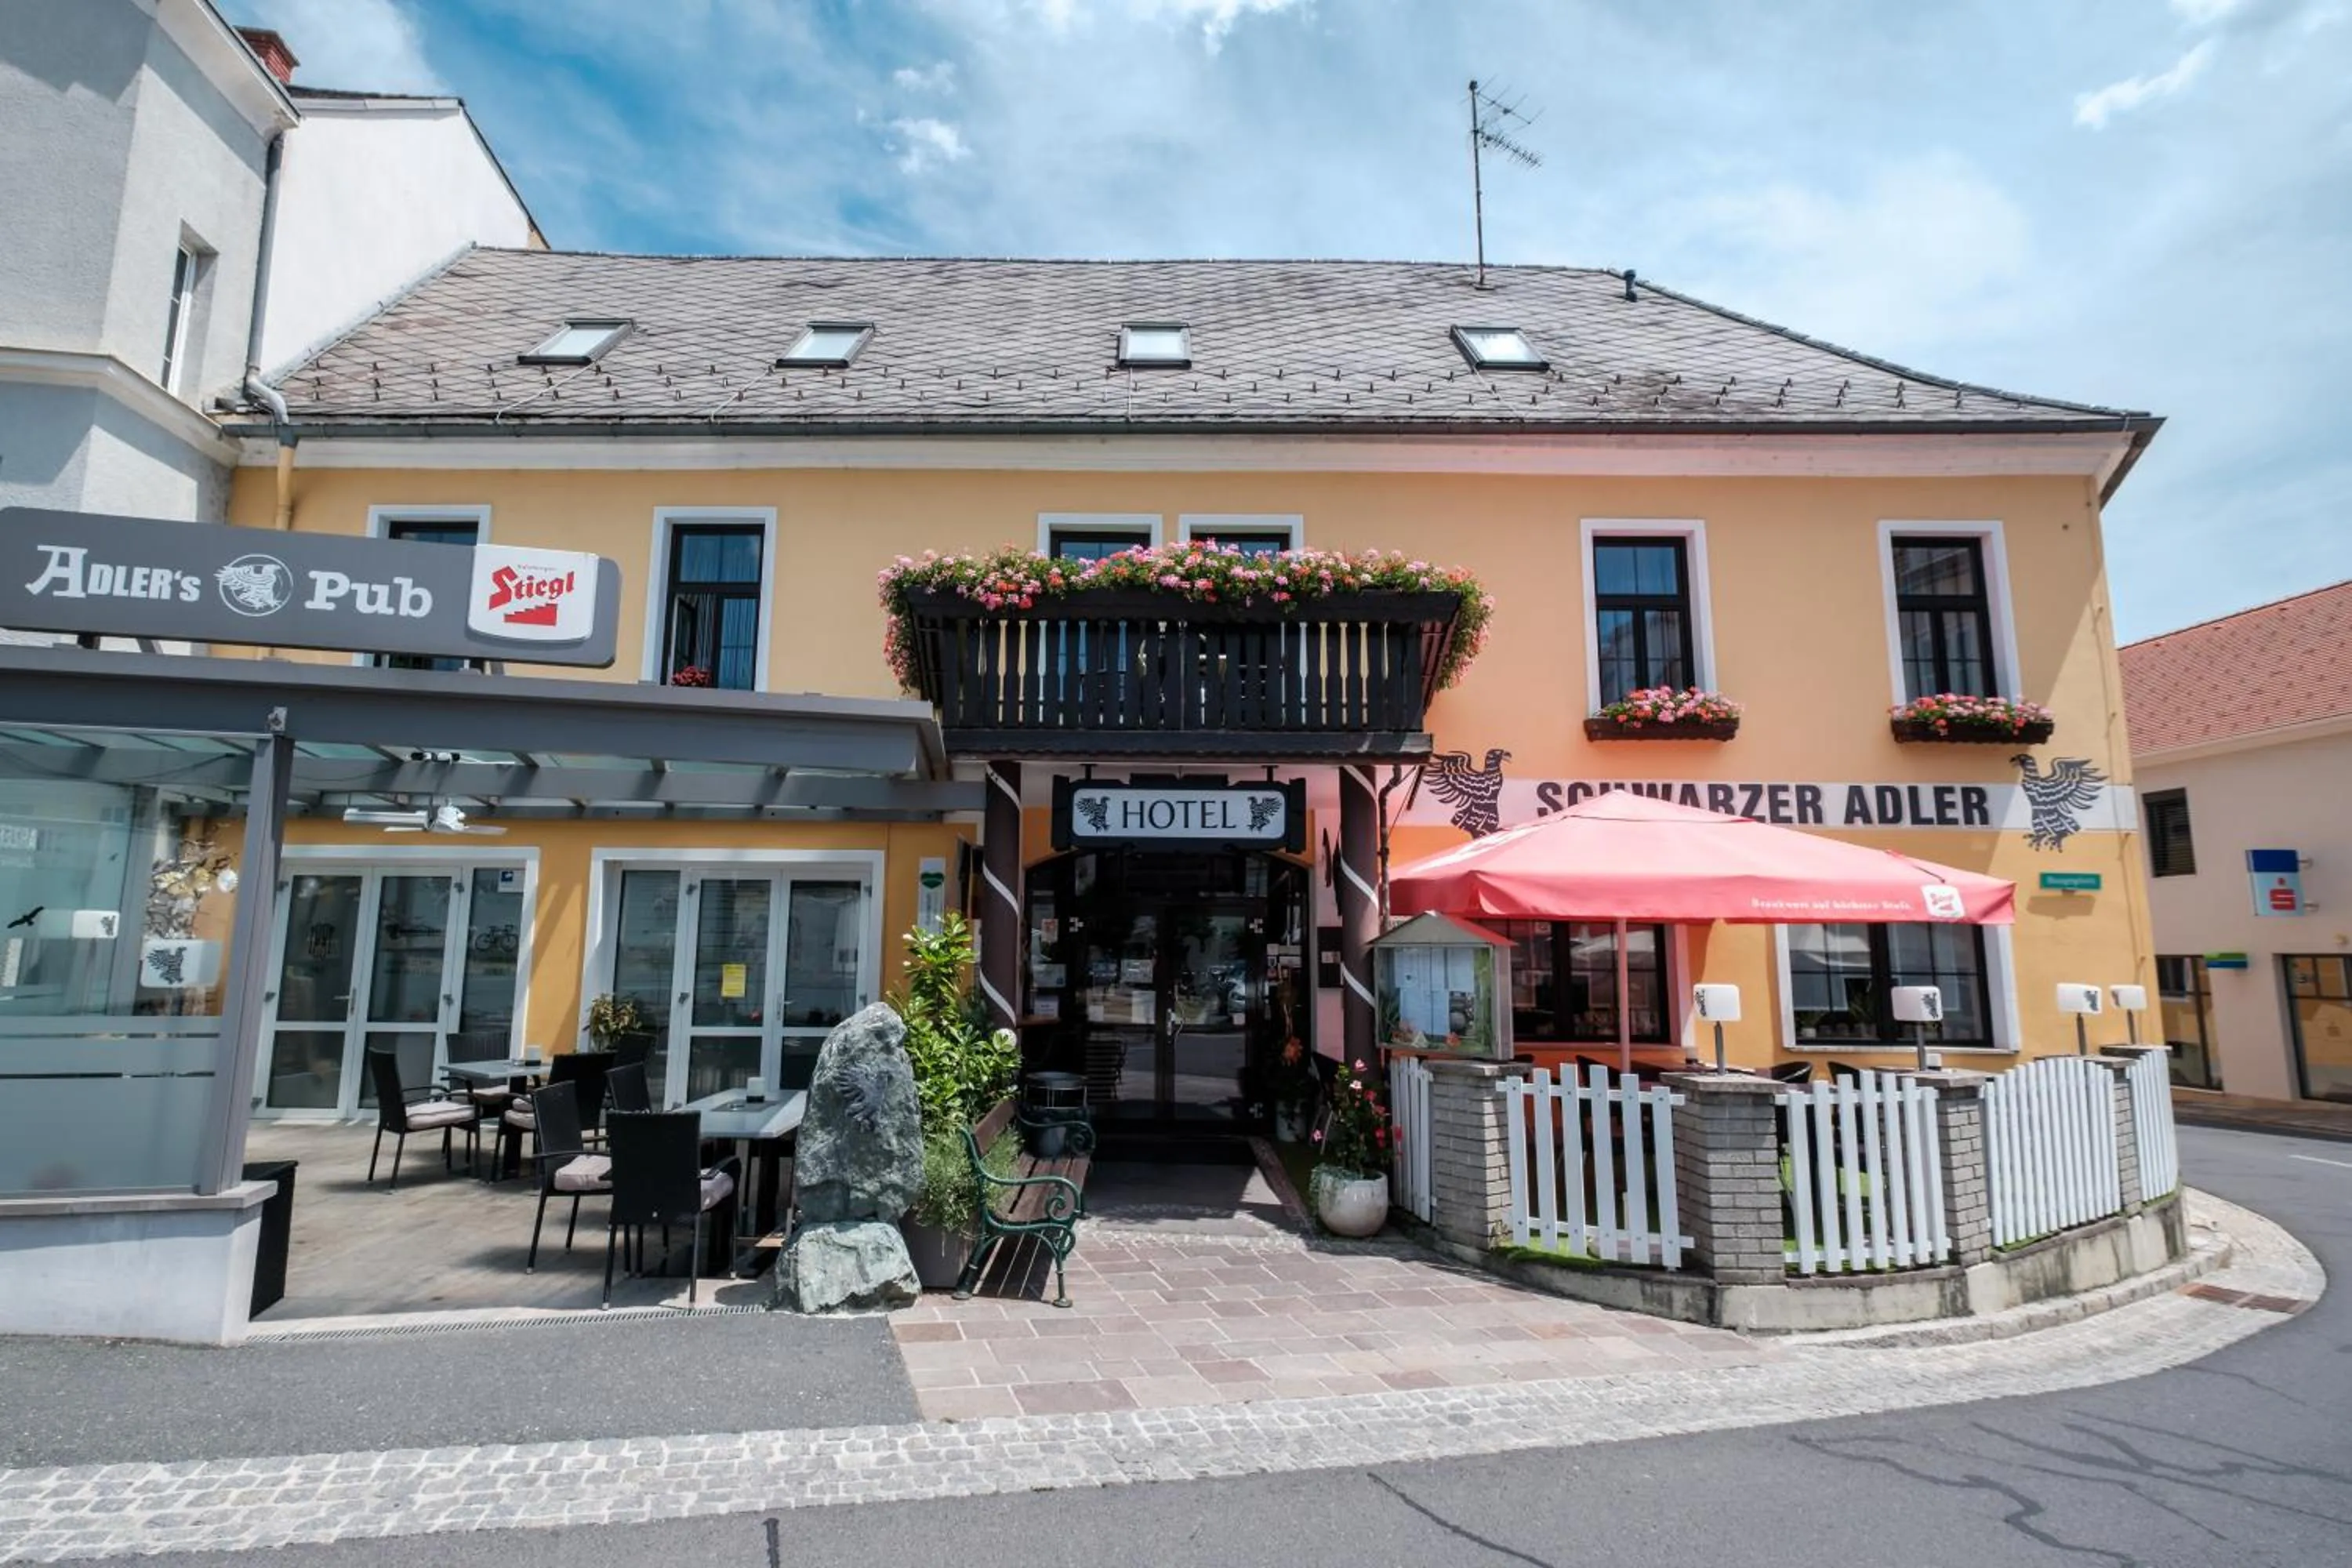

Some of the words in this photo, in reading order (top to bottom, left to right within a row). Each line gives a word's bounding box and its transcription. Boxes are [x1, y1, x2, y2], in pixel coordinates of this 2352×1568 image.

[304, 570, 434, 619] Pub
[488, 565, 575, 610] Stiegl
[1122, 799, 1236, 829] HOTEL
[1536, 782, 1823, 824] SCARZER
[1843, 785, 1990, 825] ADLER
